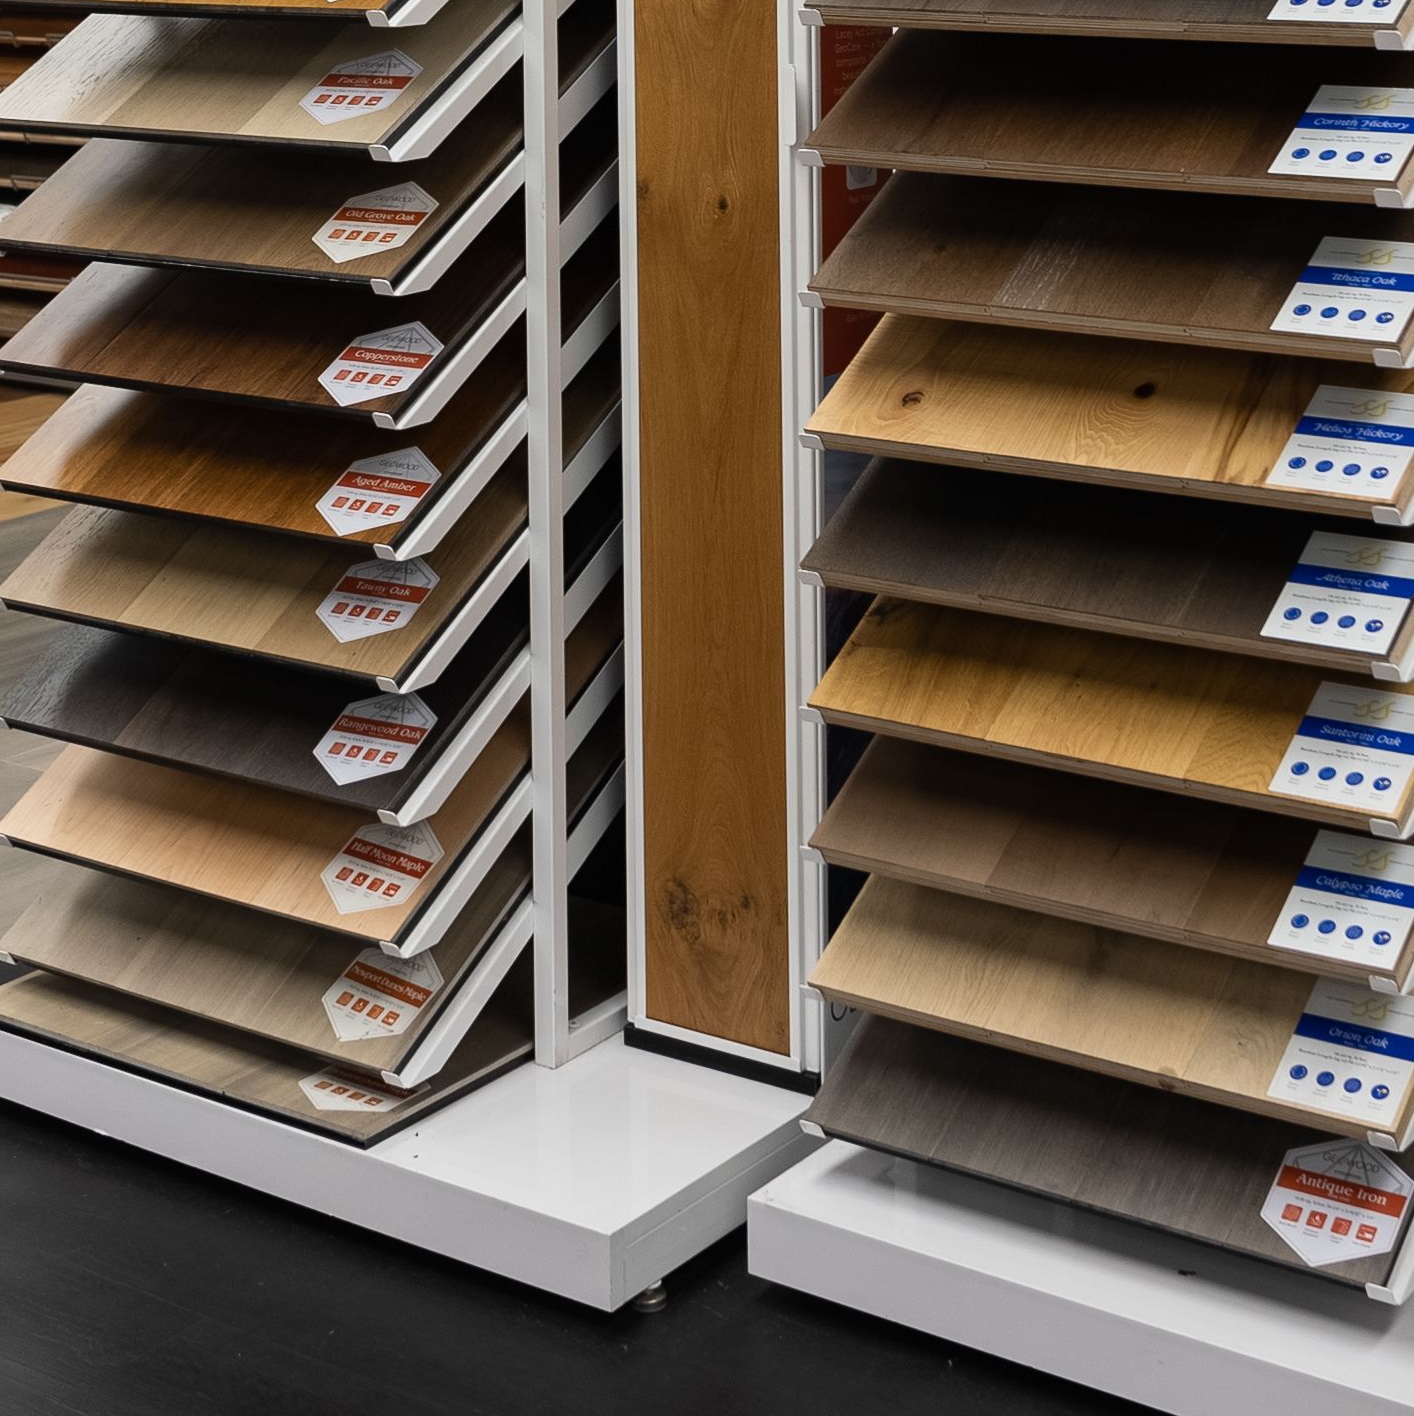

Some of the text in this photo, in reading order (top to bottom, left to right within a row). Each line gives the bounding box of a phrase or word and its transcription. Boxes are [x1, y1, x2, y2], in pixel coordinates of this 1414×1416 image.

[337, 77, 394, 85] Pacific Oak
[1314, 117, 1410, 130] Corinth Hickory
[346, 210, 415, 221] Old Grove Oak
[1332, 272, 1397, 286] Ithaca Oak
[354, 349, 419, 365] Copperstone
[1314, 422, 1403, 441] Helios Hickory
[352, 476, 416, 492] Aged Amber
[356, 581, 412, 597] Tawny Oak
[1315, 572, 1390, 590] Athena Oak
[339, 718, 423, 740] Rangewood Oak
[1320, 724, 1402, 747] Santorini Oak
[351, 840, 426, 874] Half Moon Maple
[1316, 875, 1404, 901] Calypso Maple
[353, 964, 386, 986] Newport
[402, 981, 427, 1002] Maple
[1329, 1026, 1389, 1049] Orion Oak
[1296, 1172, 1388, 1206] Antique Iron
